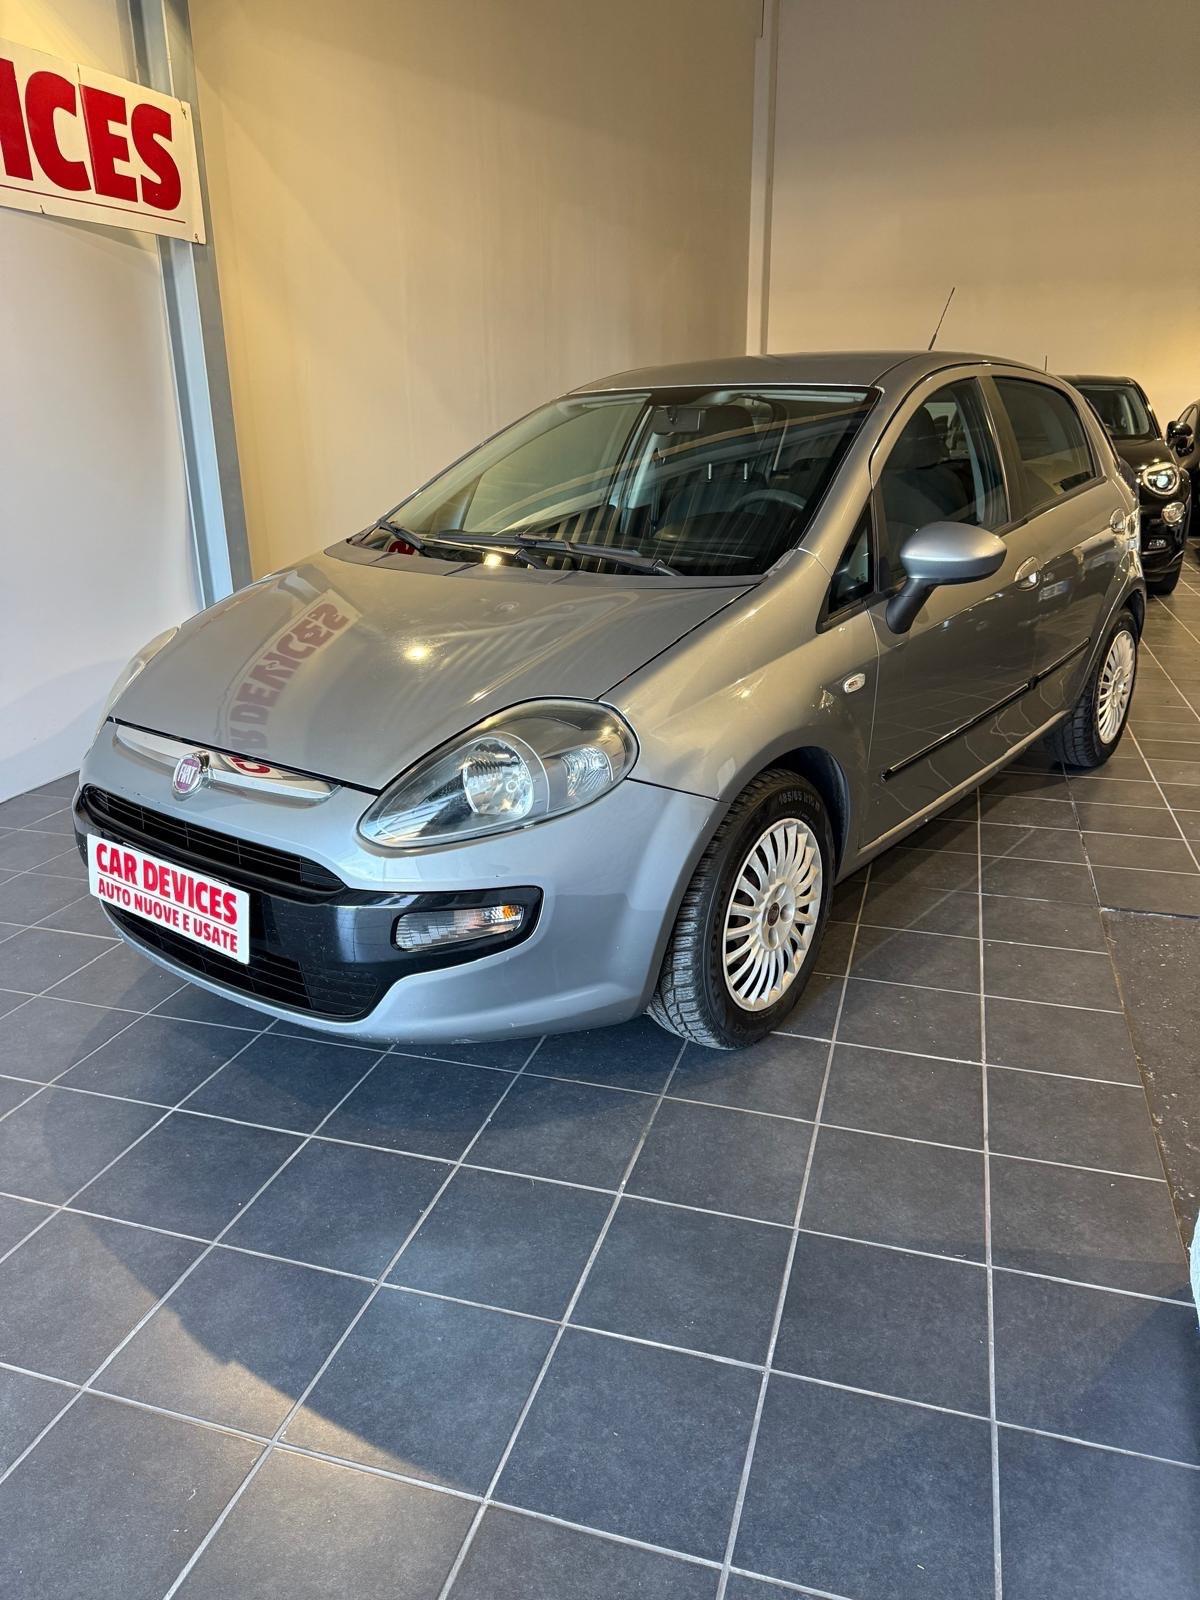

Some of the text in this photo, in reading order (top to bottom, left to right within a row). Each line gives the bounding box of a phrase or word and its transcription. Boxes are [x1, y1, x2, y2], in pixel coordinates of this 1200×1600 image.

[177, 763, 198, 785] FIAT
[96, 843, 238, 925] CAR DEVICES
[98, 877, 238, 954] AUTO NUOVE E USATE
